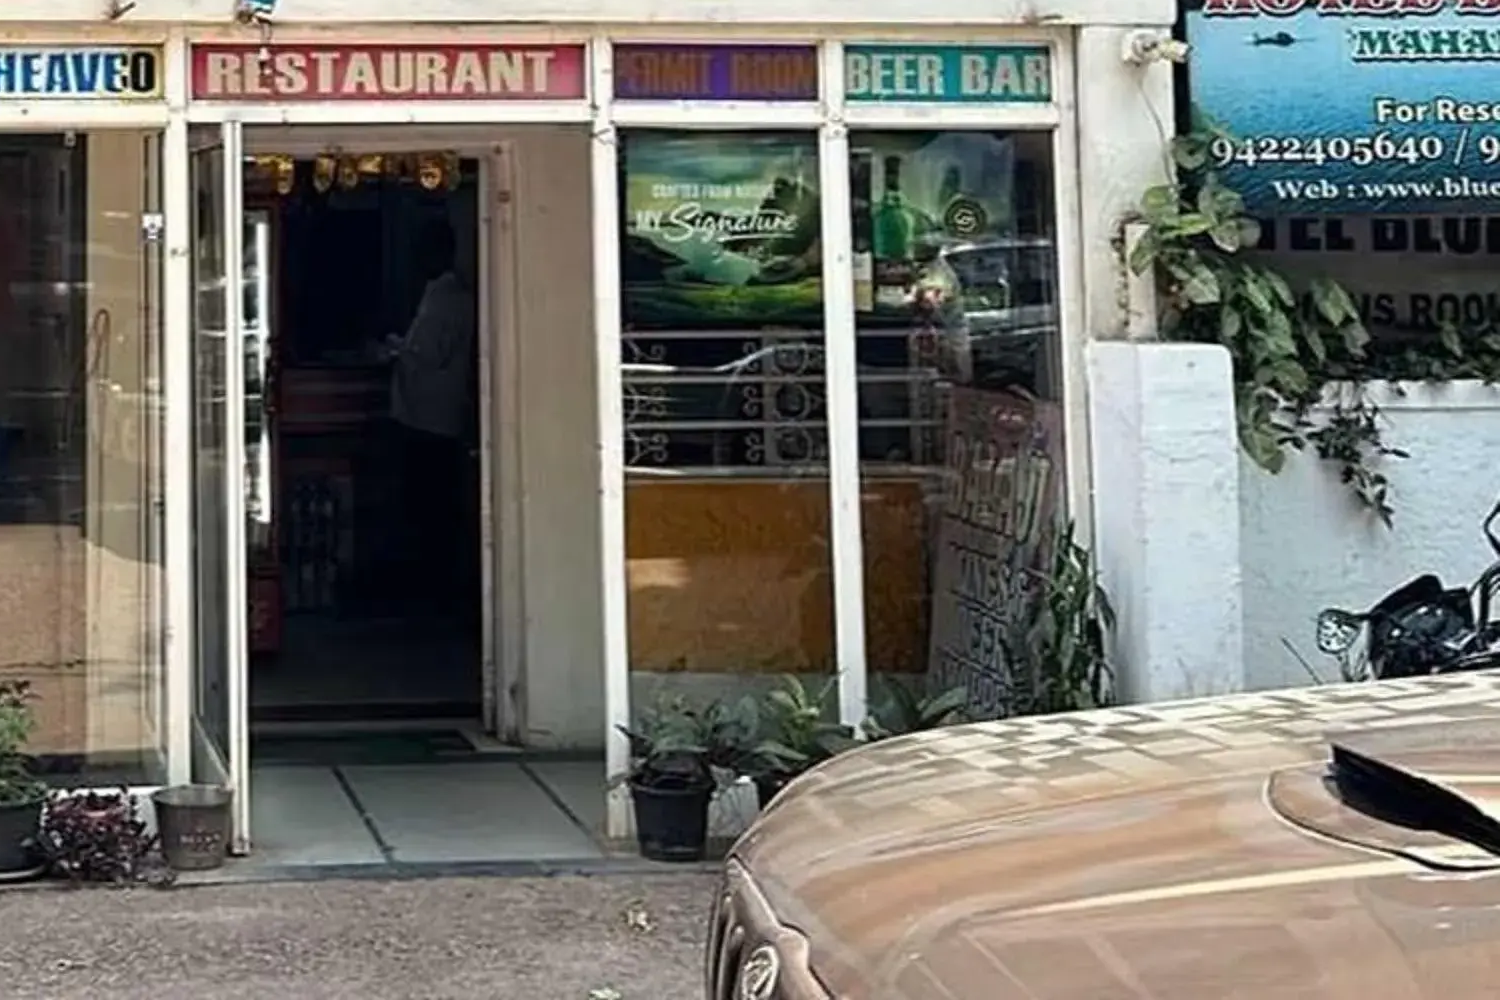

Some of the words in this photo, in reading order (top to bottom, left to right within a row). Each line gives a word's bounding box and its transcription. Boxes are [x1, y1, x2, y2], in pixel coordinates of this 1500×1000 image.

[1357, 29, 1500, 55] MAHA
[205, 50, 554, 94] RESTAURANT
[845, 54, 944, 96] BEER
[960, 54, 1049, 96] BAR
[1376, 100, 1428, 122] For
[1212, 131, 1443, 168] 9422405640
[1275, 180, 1338, 200] Web
[663, 202, 799, 243] Signature
